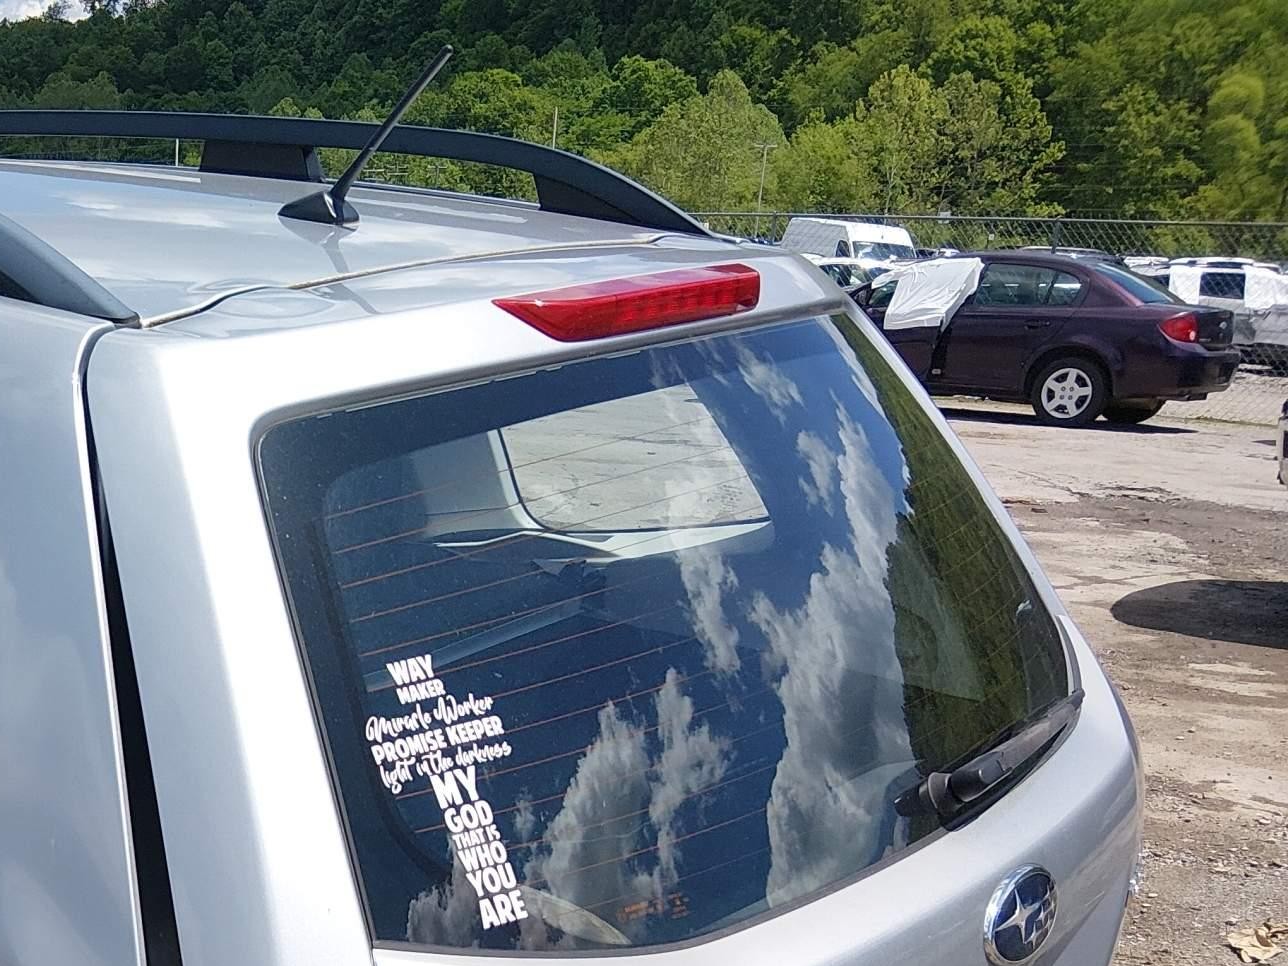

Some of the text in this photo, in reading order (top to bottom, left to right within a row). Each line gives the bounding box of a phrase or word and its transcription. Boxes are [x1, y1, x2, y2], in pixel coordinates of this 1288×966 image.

[386, 654, 435, 685] WAY
[396, 679, 446, 704] MAKER
[433, 693, 493, 724] Worker
[371, 716, 505, 765] PROMISE KEEPER
[380, 756, 416, 794] light
[456, 741, 512, 767] darkness
[429, 765, 479, 809] MY
[444, 800, 493, 833] GOD
[452, 824, 501, 850] THAT IS
[458, 841, 508, 872] WHO
[466, 862, 517, 897] YOU
[479, 890, 528, 930] ARE
